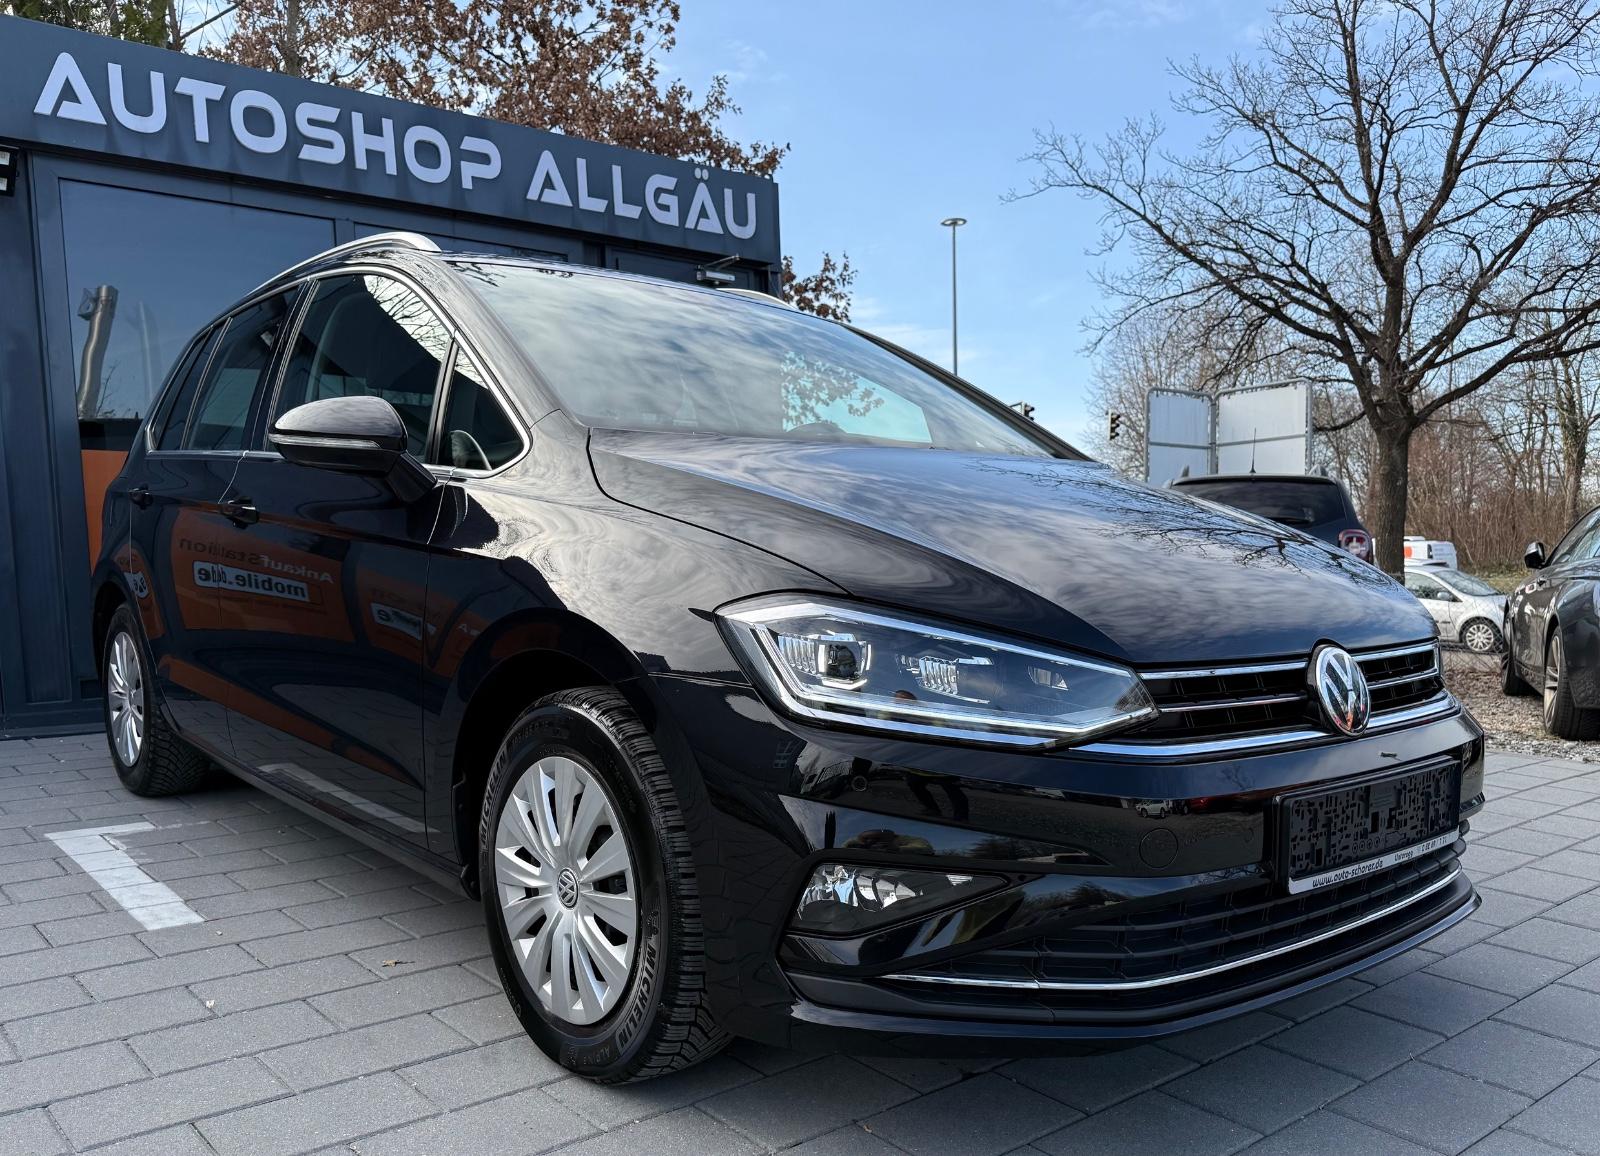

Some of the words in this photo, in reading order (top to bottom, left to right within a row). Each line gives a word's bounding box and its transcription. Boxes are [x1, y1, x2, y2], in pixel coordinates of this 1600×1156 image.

[33, 52, 502, 190] AUTOSHOP
[526, 149, 757, 240] ALLGÄU
[617, 943, 657, 1049] MICHELIN
